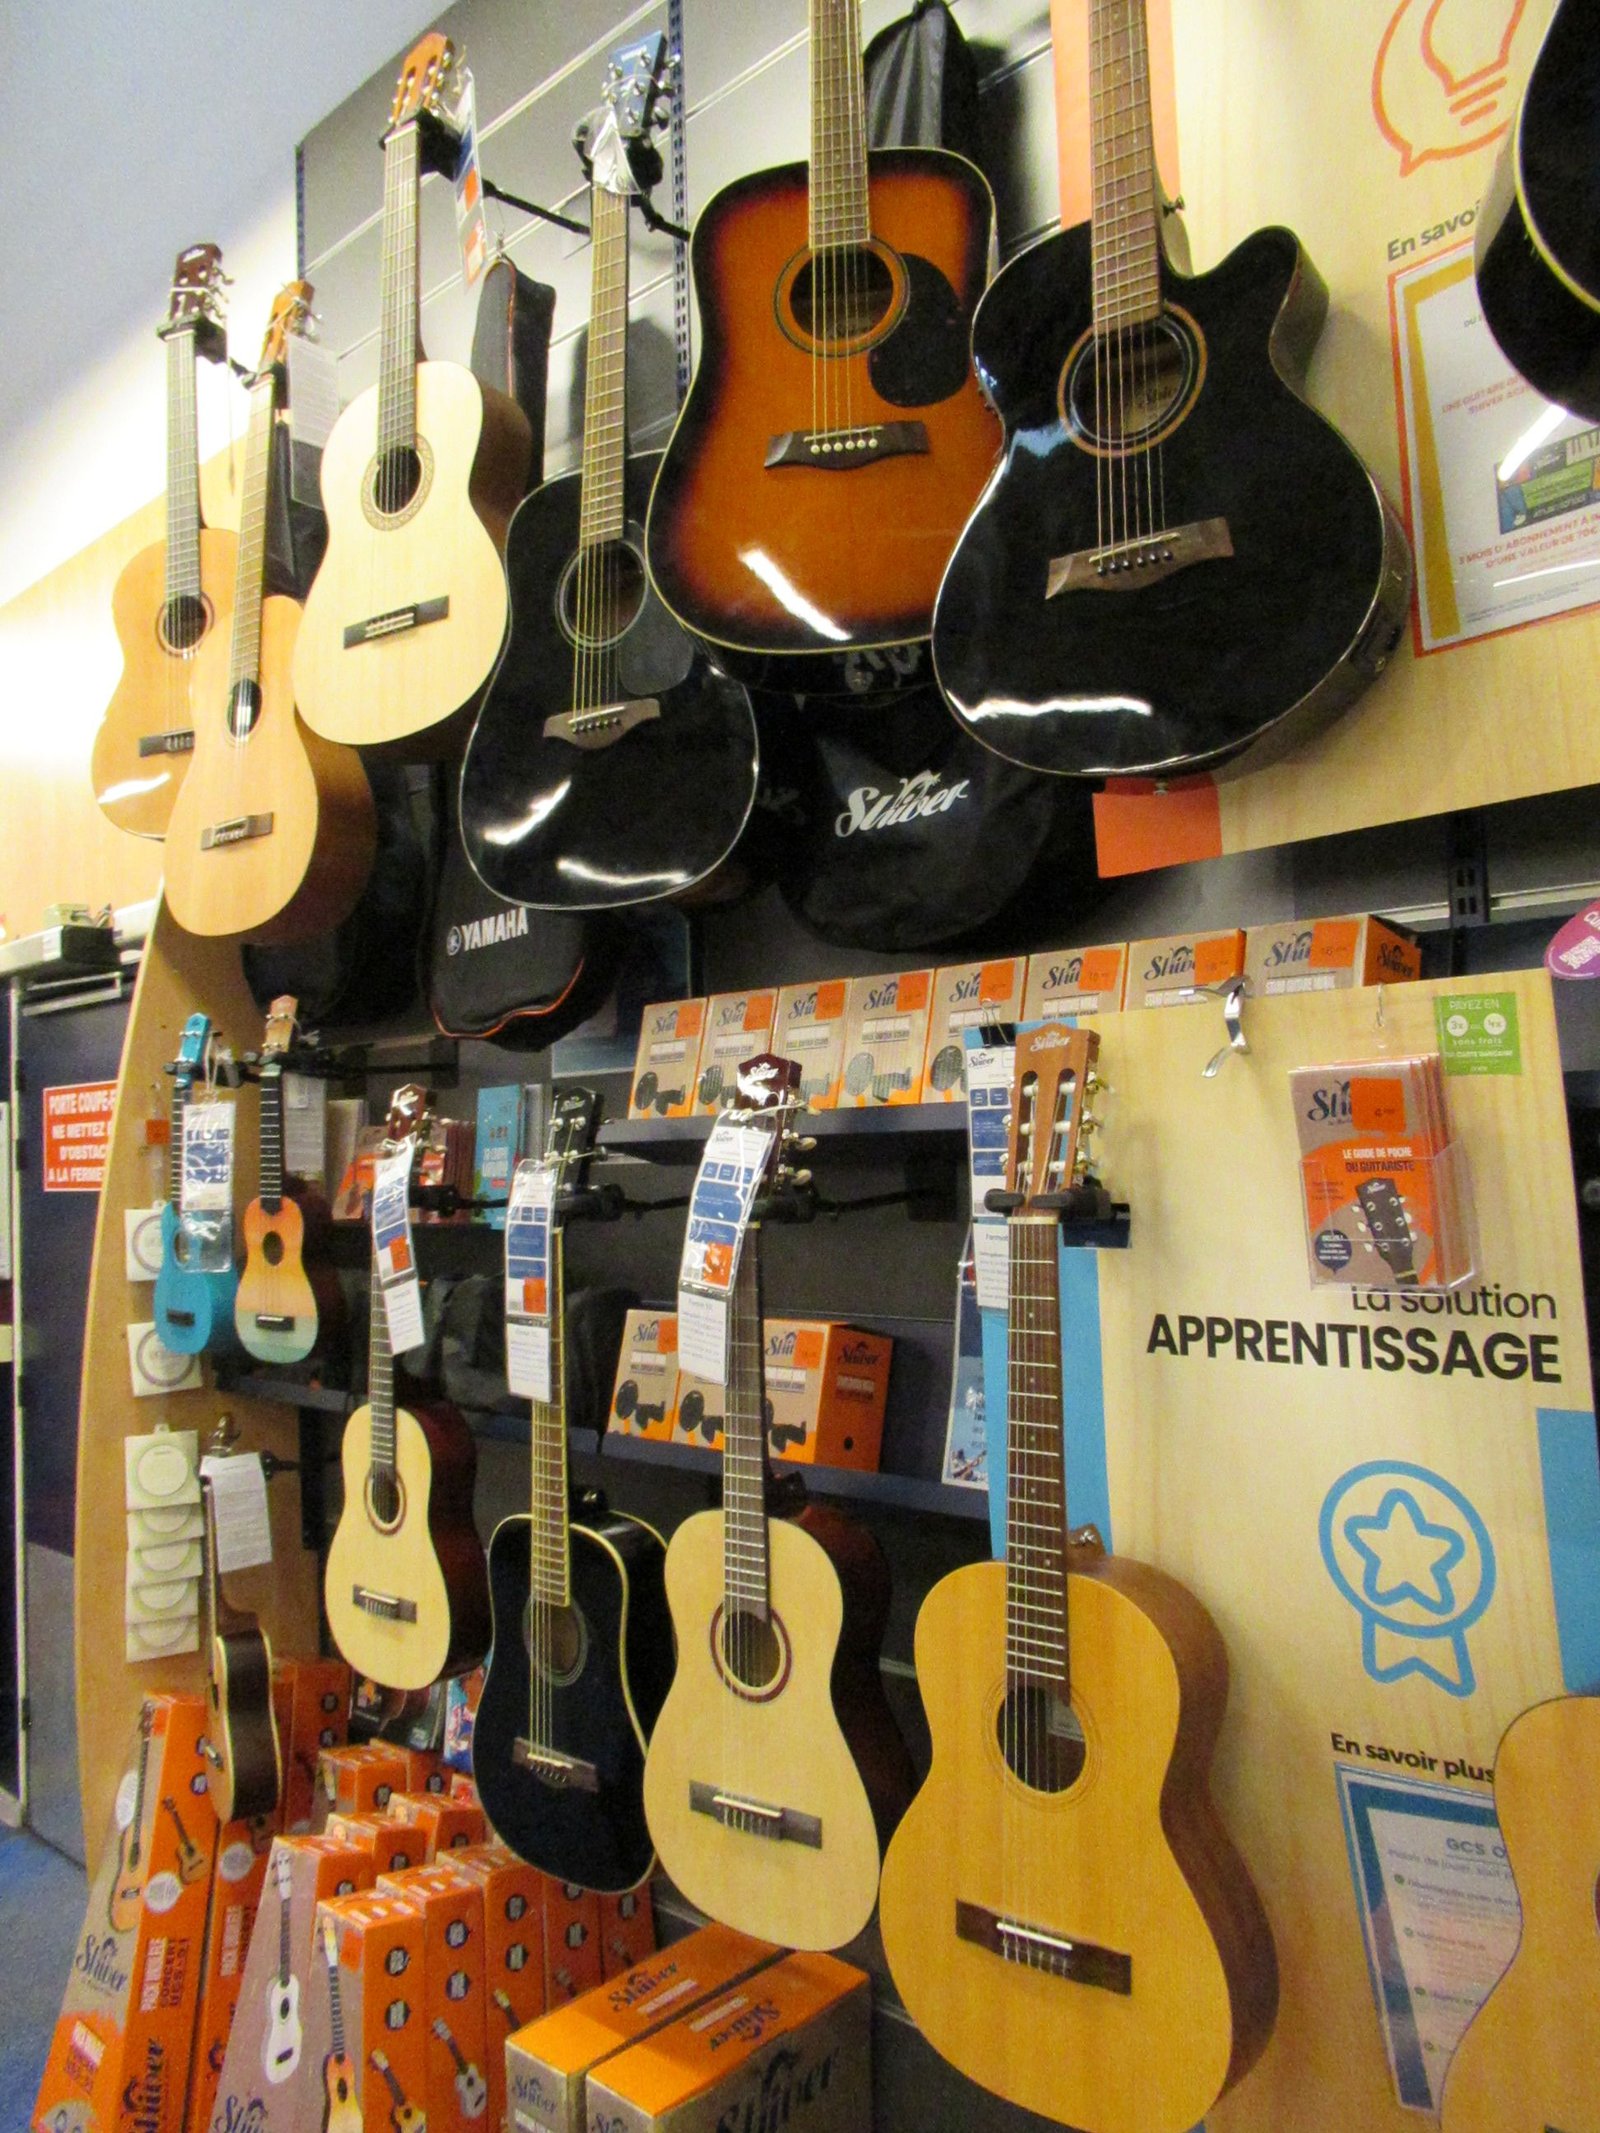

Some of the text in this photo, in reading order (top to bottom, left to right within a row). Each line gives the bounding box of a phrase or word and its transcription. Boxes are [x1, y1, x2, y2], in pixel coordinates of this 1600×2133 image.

[1388, 238, 1415, 262] En
[461, 906, 529, 952] YAMAHA
[1484, 999, 1500, 1009] EN
[49, 1093, 77, 1115] PORTE
[66, 1121, 105, 1138] METTEZ
[1342, 1146, 1412, 1159] LE GUIDE DE POCHE
[56, 1166, 68, 1183] LA
[1346, 1160, 1415, 1172] DU GUITARISTE
[1352, 1284, 1557, 1319] La solution
[1147, 1313, 1562, 1383] APPRENTISSAGE
[1331, 1732, 1495, 1784] En savoir plus
[1446, 1837, 1486, 1856] GCS
